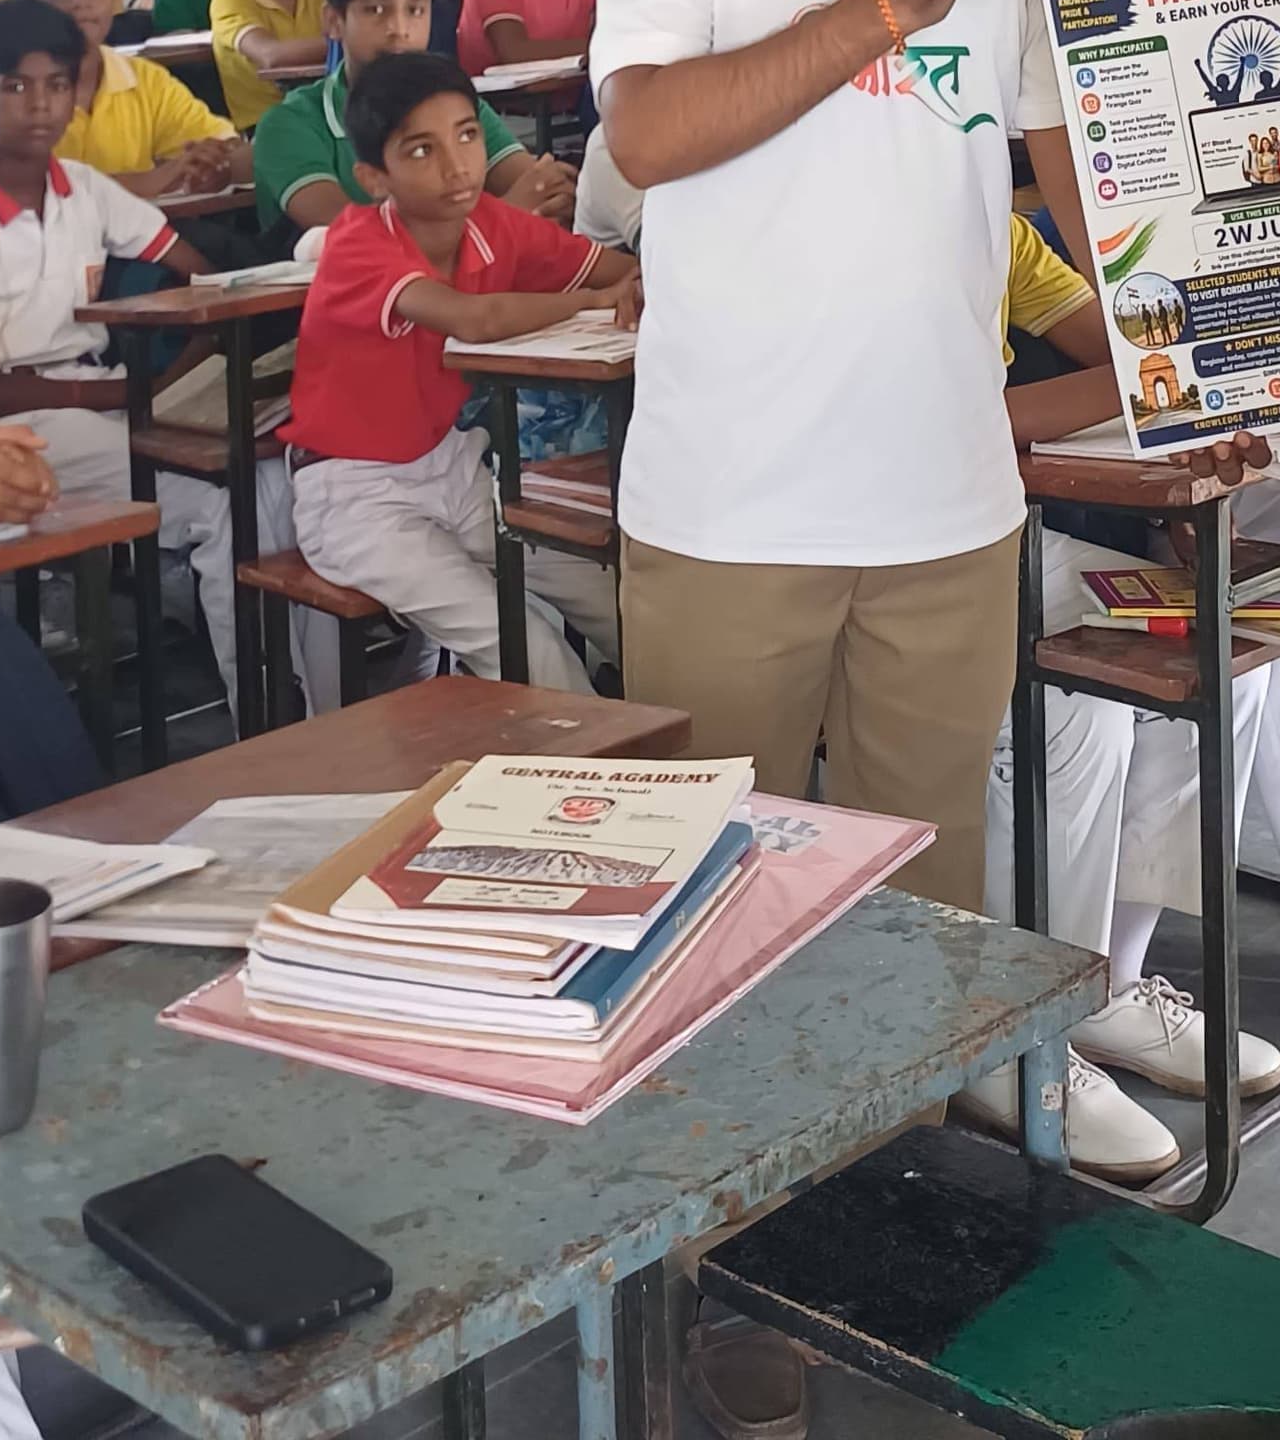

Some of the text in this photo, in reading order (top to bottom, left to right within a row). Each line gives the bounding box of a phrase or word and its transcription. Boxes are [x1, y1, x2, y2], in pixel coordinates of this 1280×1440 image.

[1155, 11, 1165, 24] &
[1169, 4, 1207, 22] EARN
[501, 766, 721, 784] CENTRAL ACADEMY
